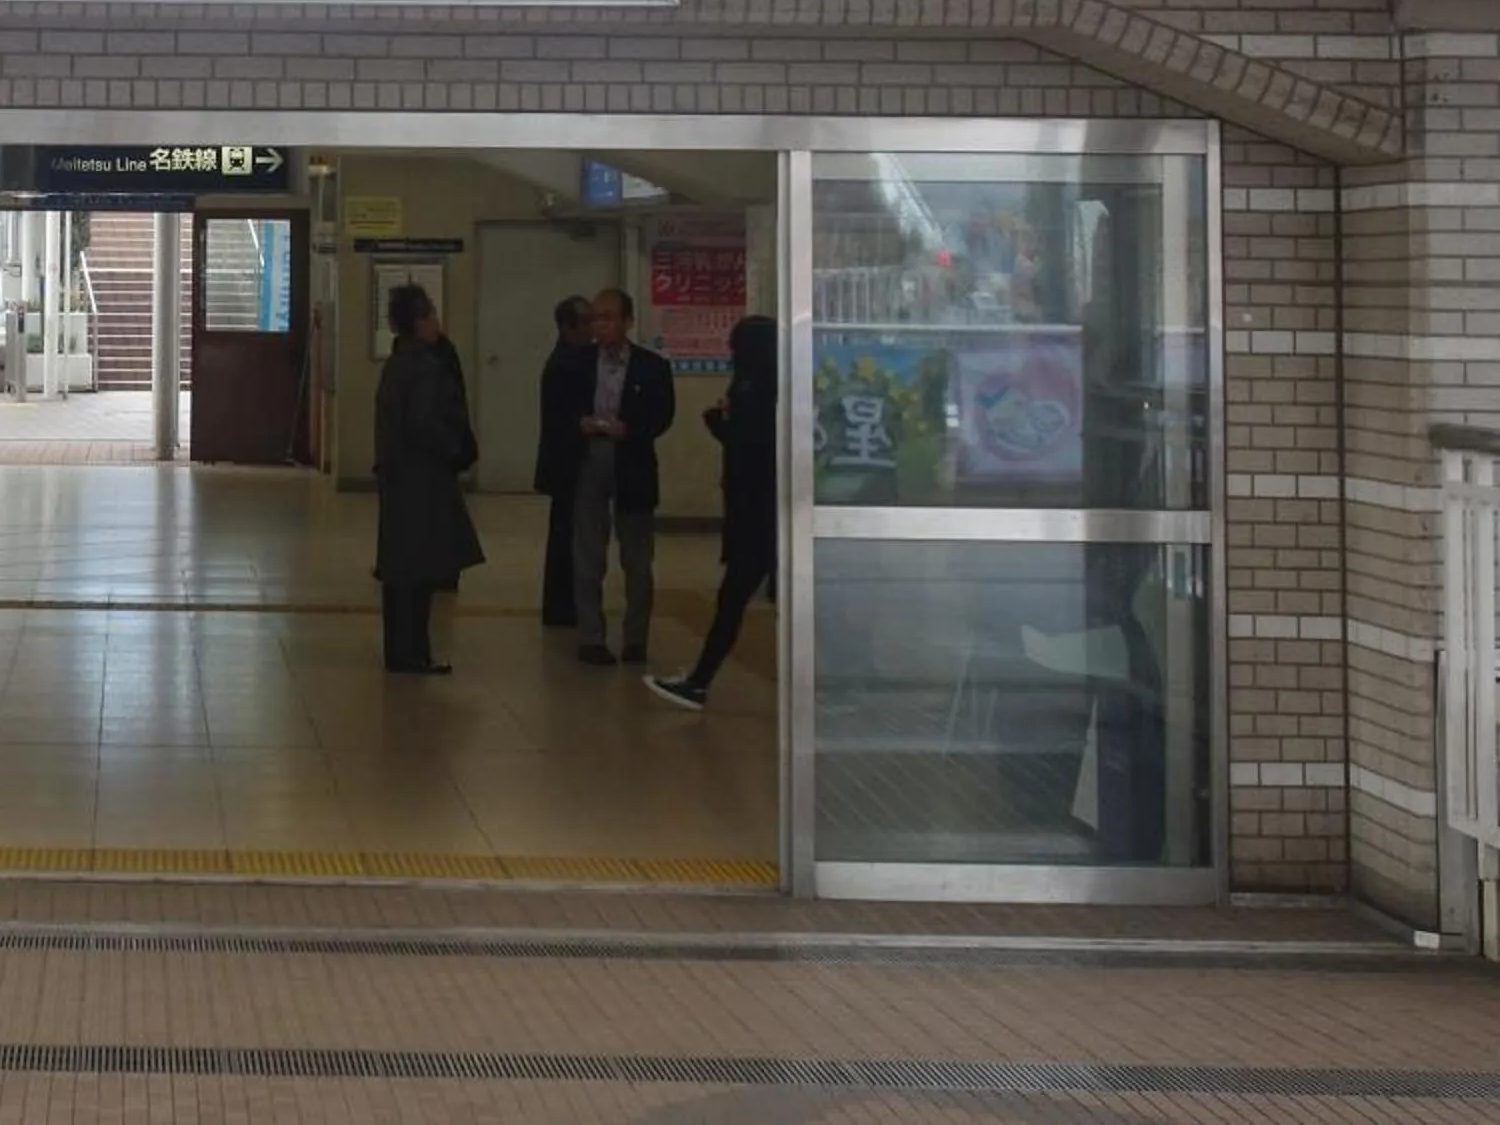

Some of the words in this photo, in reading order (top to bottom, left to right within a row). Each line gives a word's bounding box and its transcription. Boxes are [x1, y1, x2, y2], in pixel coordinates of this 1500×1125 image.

[116, 157, 147, 172] Line
[150, 148, 217, 171] 名鉄線
